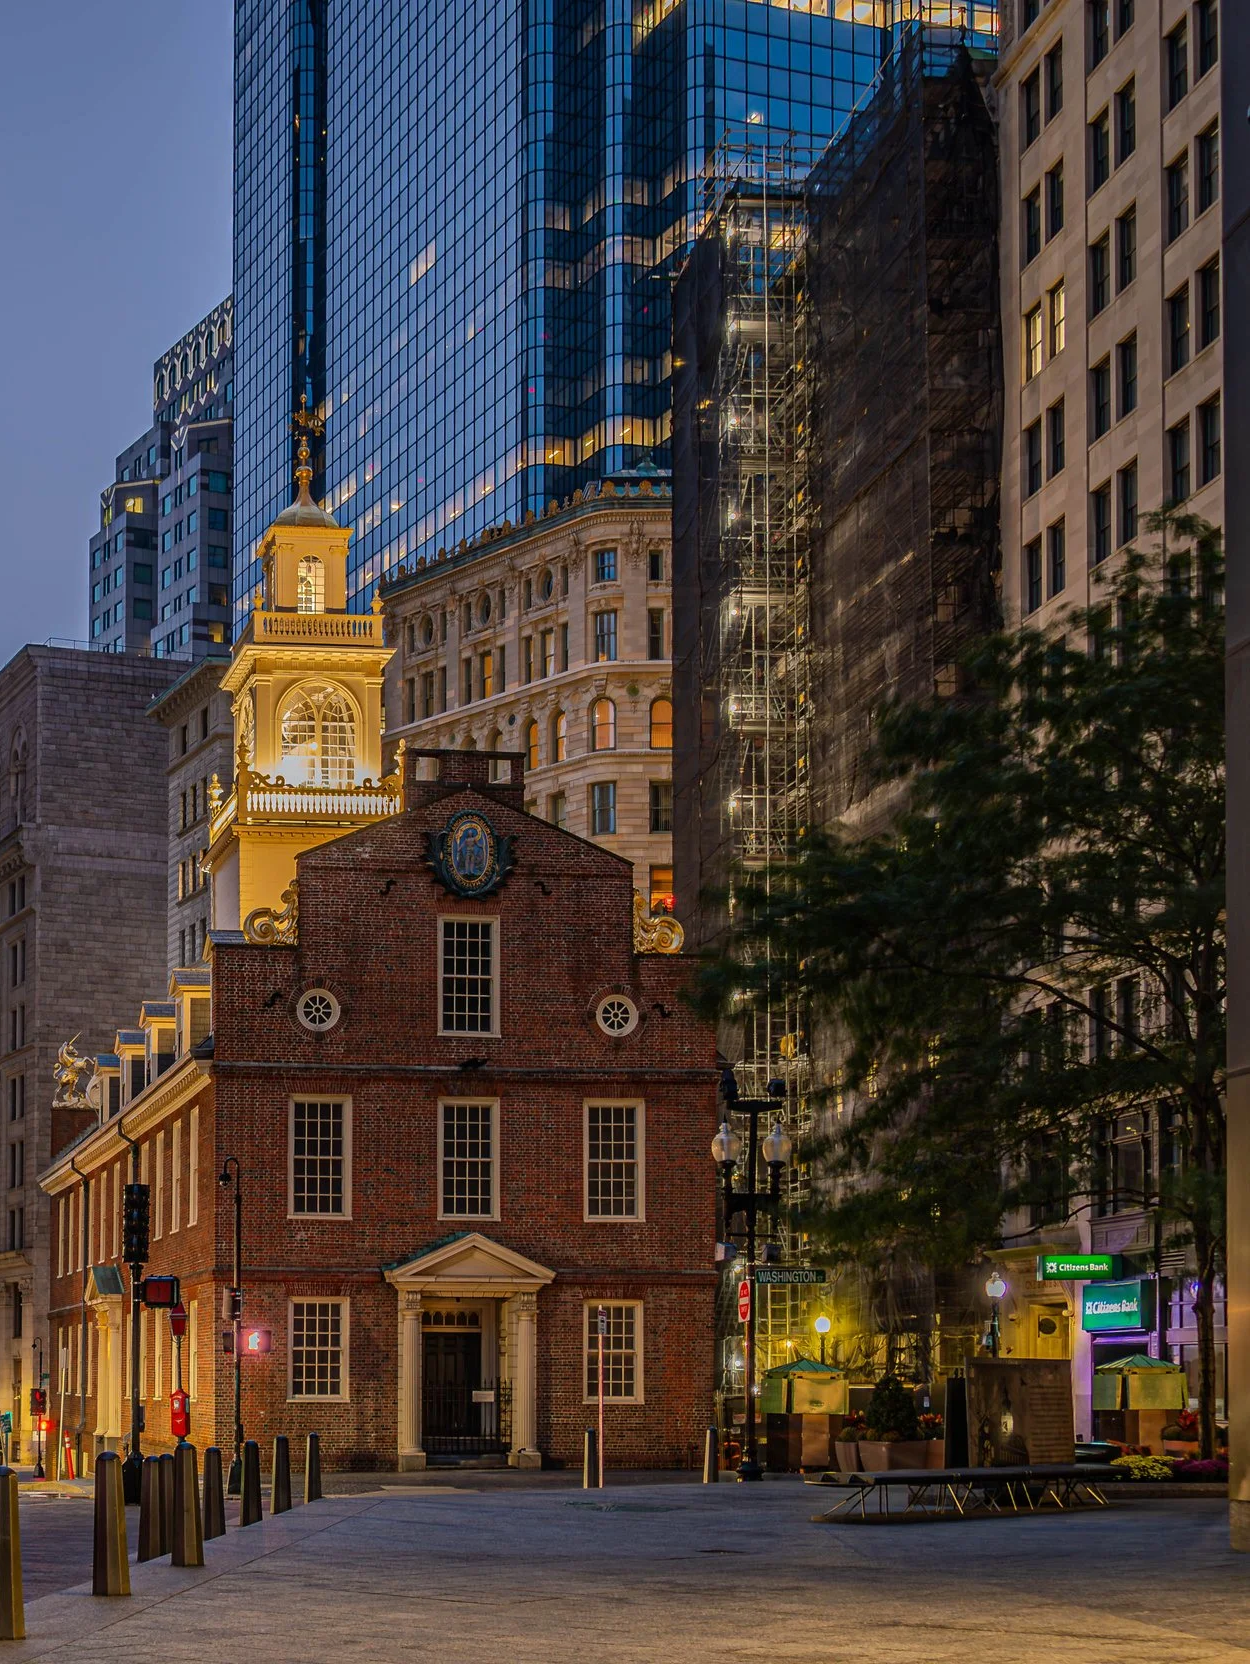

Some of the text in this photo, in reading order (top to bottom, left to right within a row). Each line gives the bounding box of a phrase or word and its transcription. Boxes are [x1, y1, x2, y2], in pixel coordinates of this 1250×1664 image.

[1058, 1262, 1109, 1272] Citizens Bank
[758, 1271, 817, 1283] WASHINGTON
[1092, 1298, 1138, 1314] Citizens Bank
